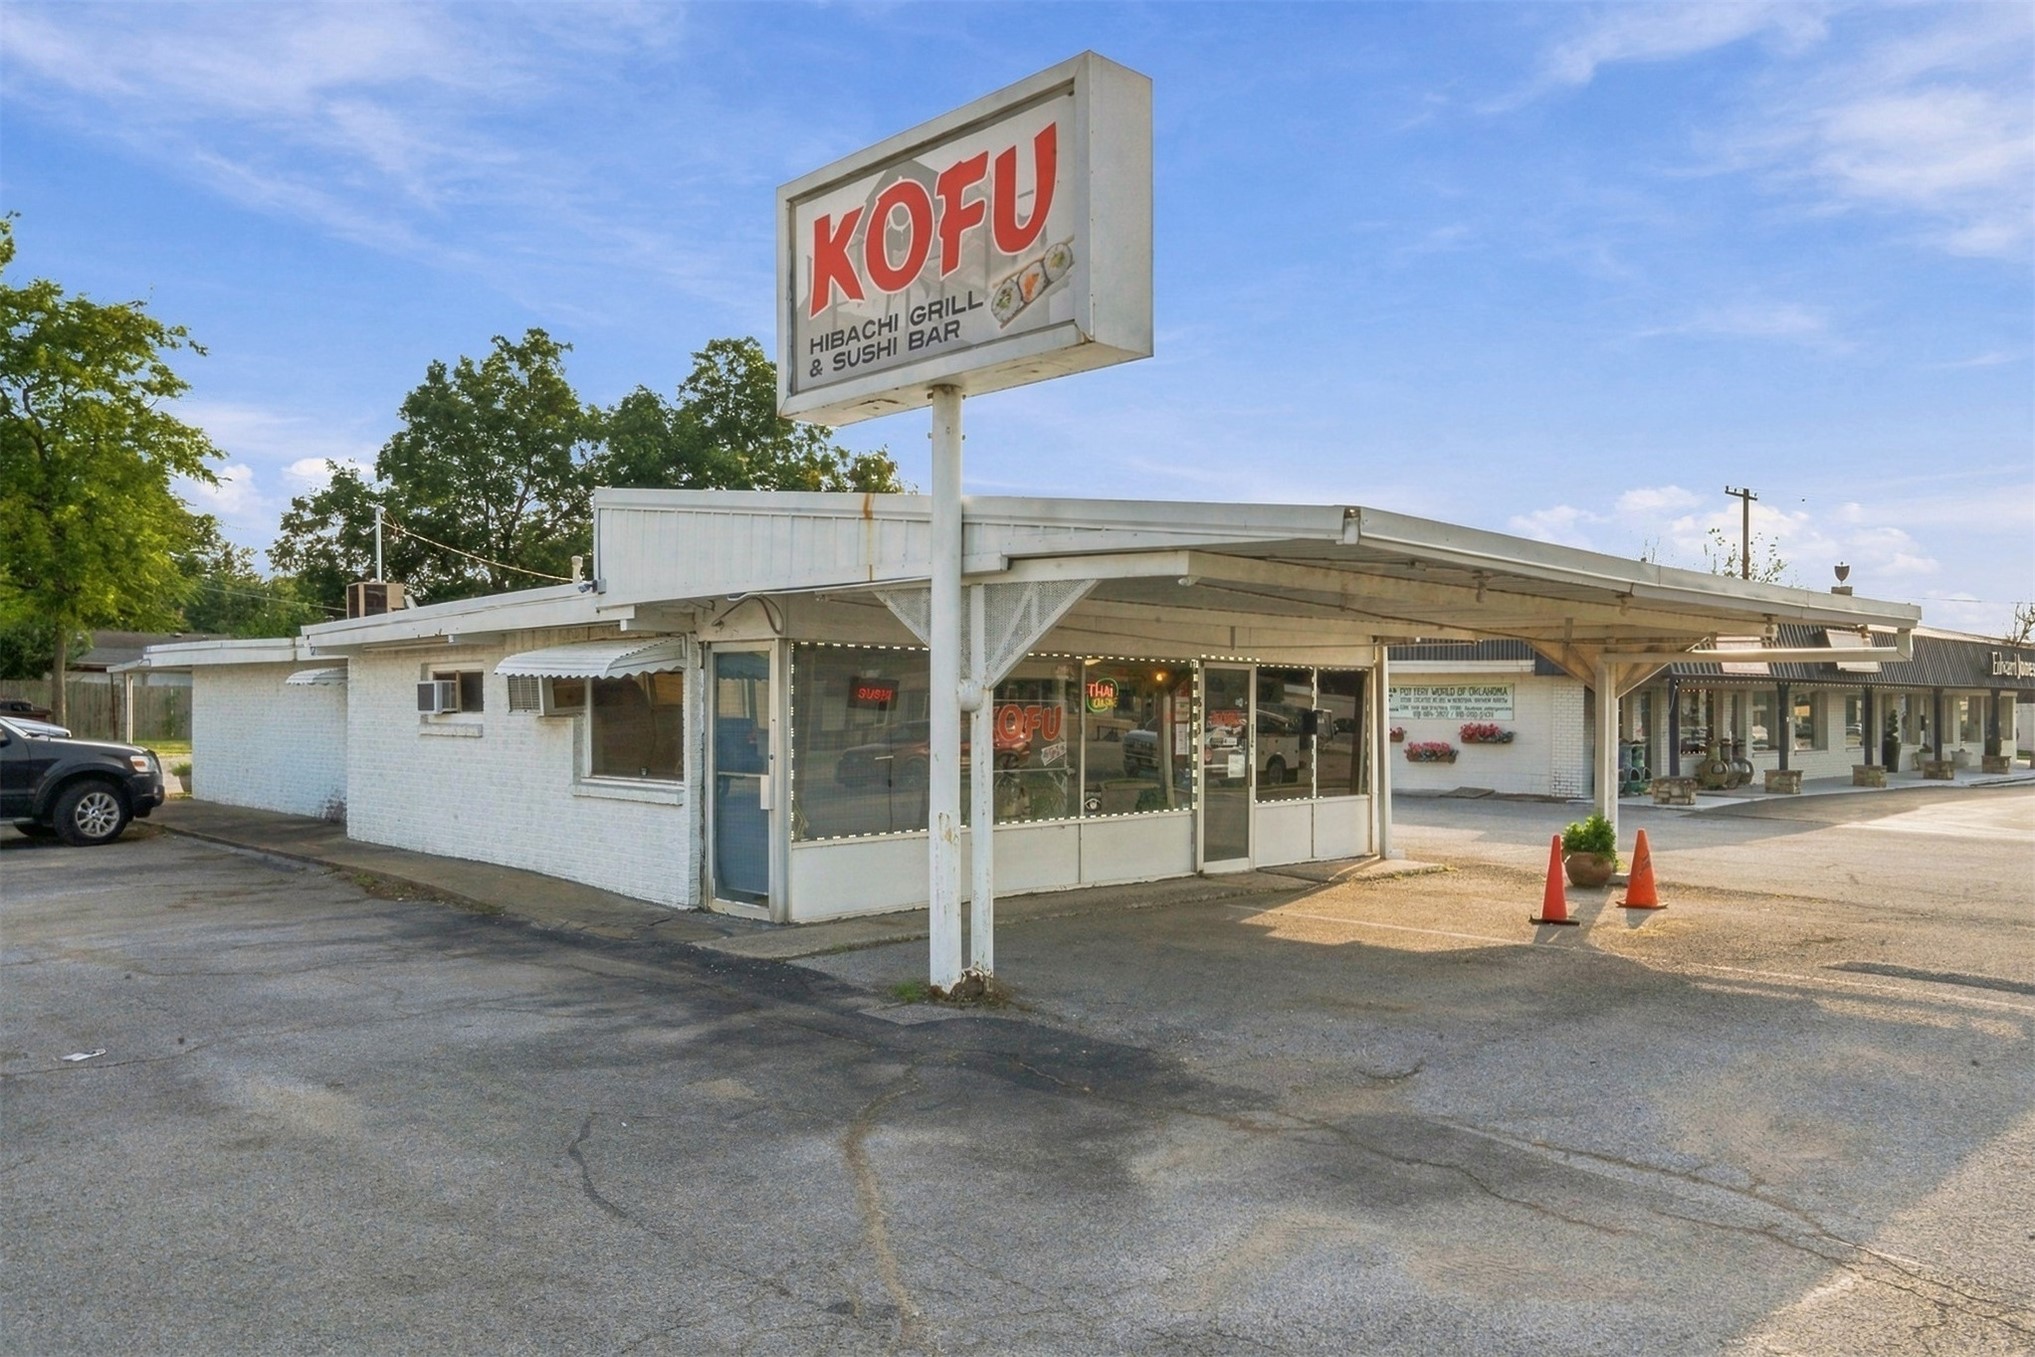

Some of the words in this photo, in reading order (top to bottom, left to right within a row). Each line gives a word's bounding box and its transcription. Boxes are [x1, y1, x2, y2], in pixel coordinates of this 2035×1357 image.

[810, 121, 1057, 319] KOFU
[809, 358, 823, 378] &
[833, 337, 897, 371] SUSHI
[908, 320, 961, 351] BAR
[810, 313, 899, 355] HIBACHI
[910, 291, 983, 326] GRILL
[1432, 687, 1455, 696] WORLD
[1457, 687, 1467, 696] OF
[1469, 686, 1508, 696] OKLAHOMA
